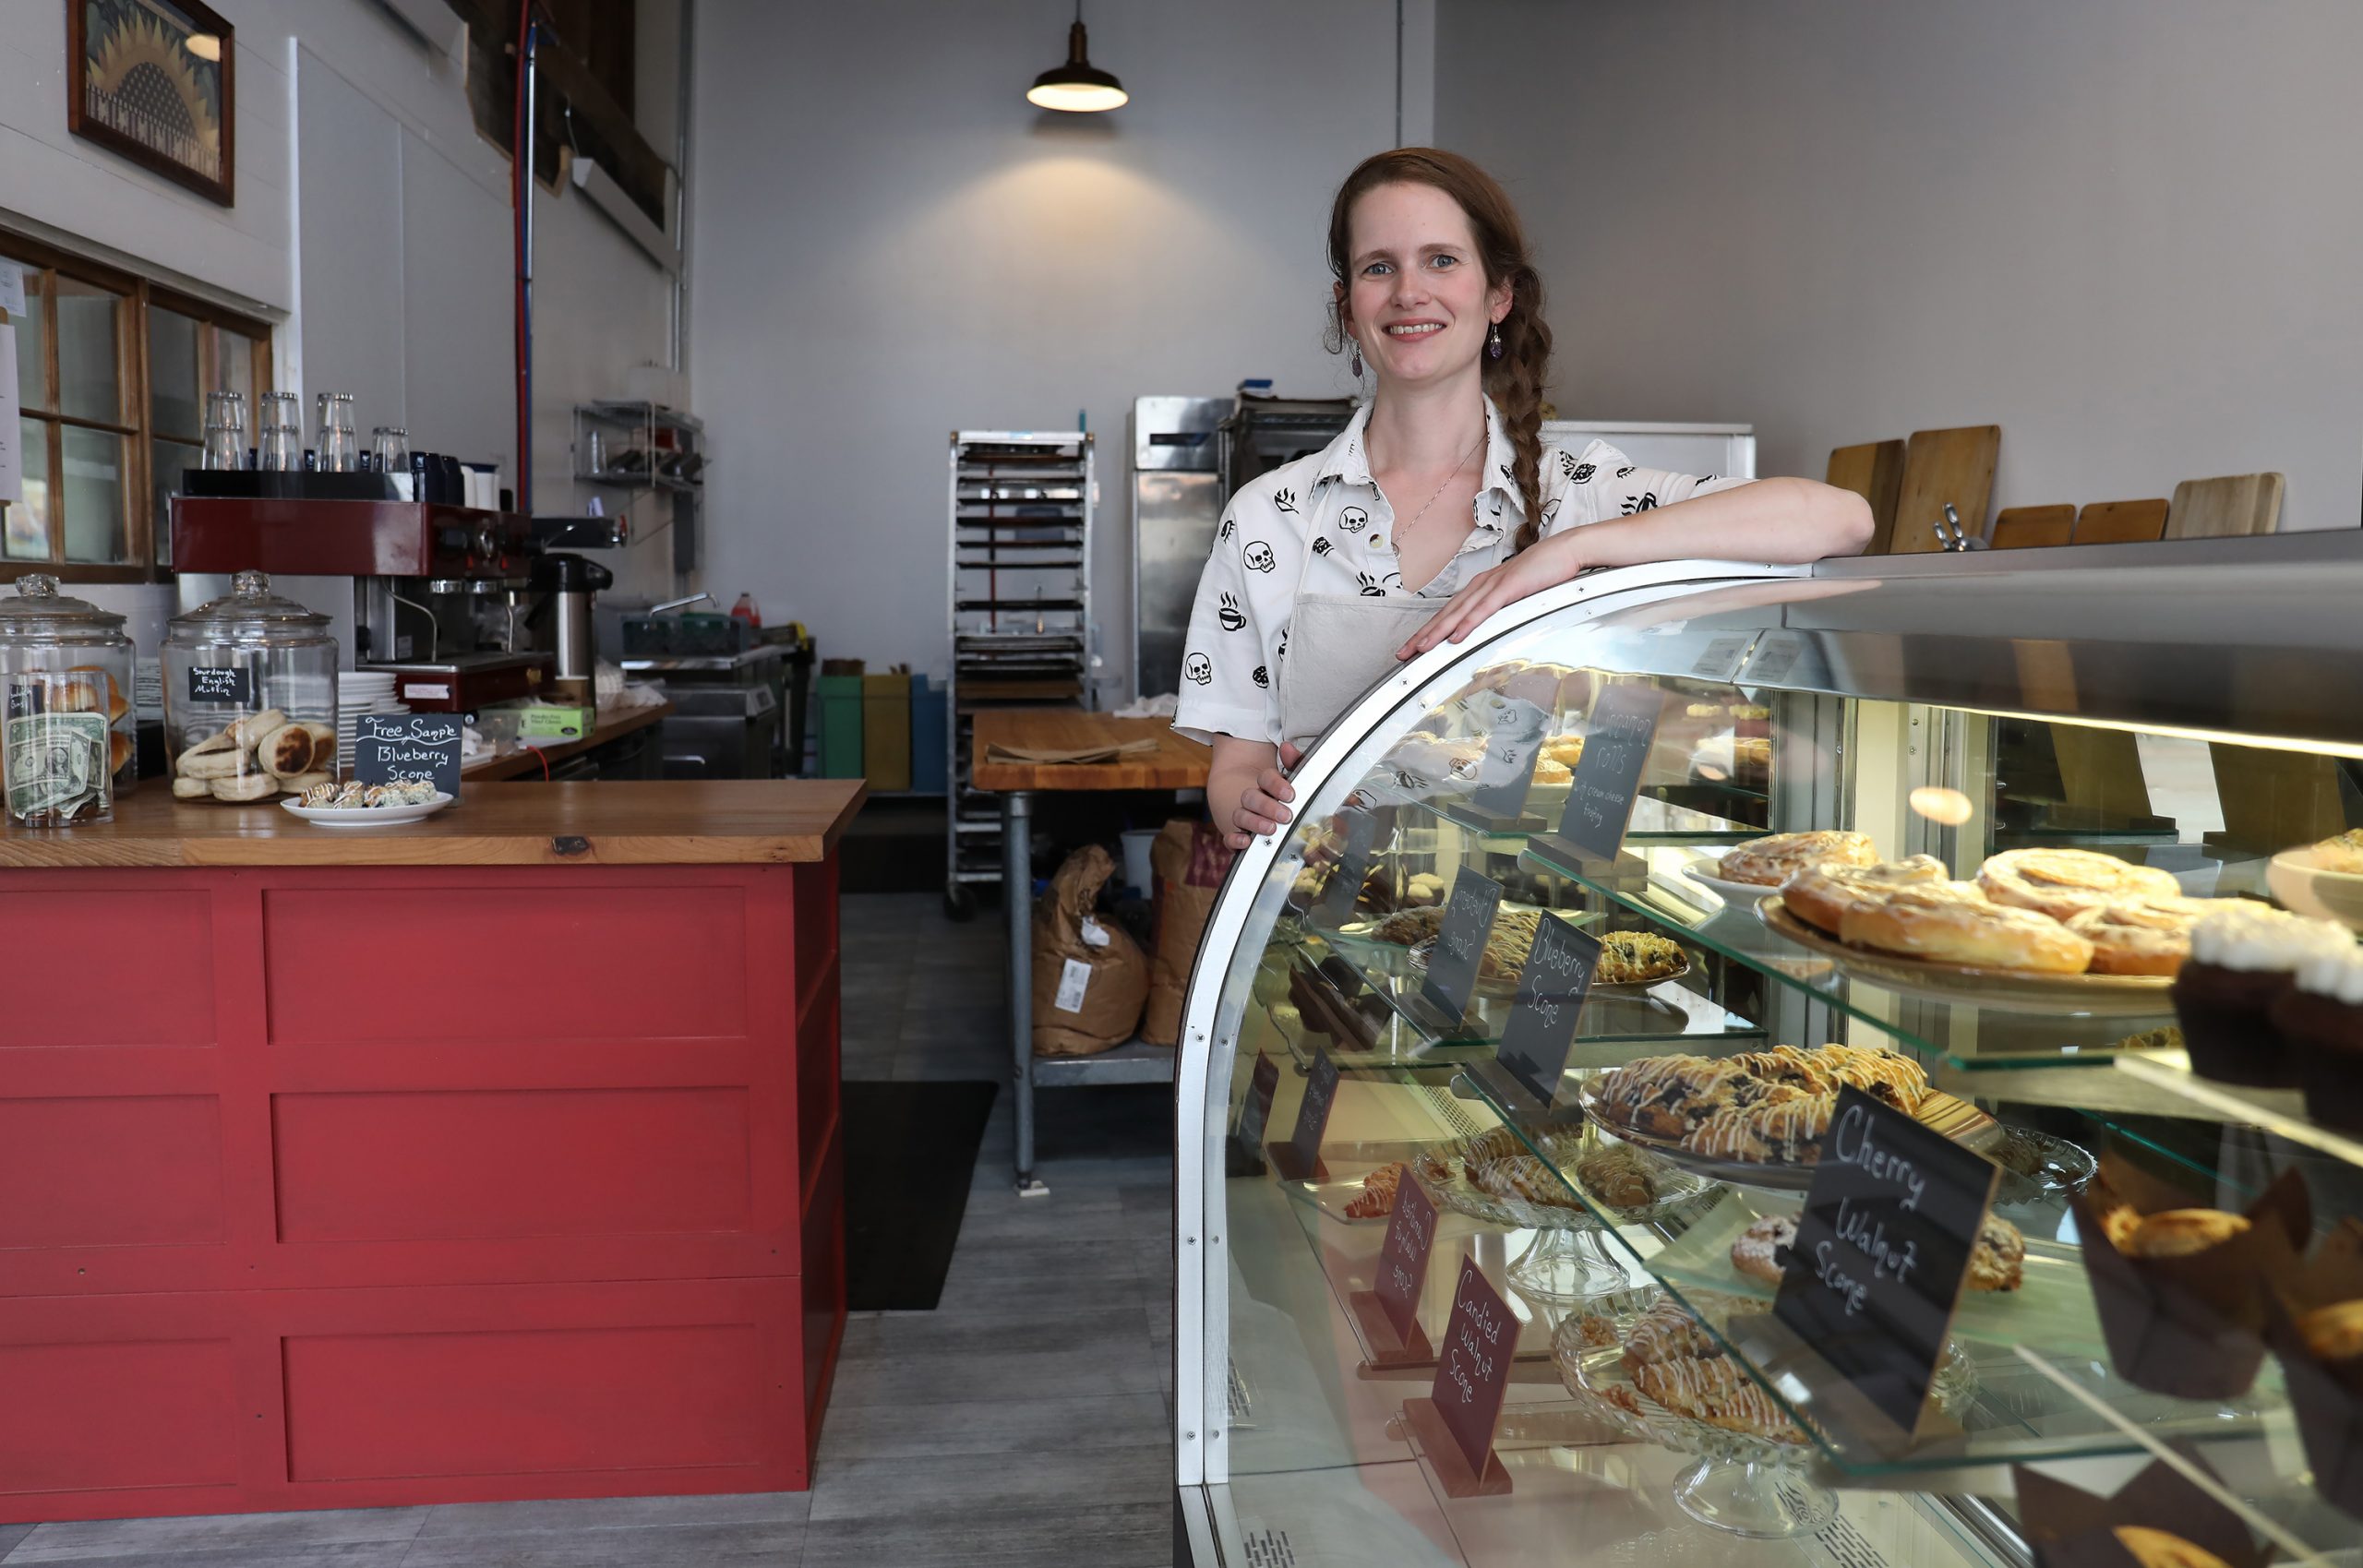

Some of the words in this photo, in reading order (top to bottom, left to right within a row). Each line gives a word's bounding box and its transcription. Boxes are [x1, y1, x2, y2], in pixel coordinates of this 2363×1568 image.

[192, 667, 236, 678] Sourdough
[194, 685, 231, 696] Muffin
[201, 676, 235, 687] English
[366, 716, 403, 736] Free
[411, 719, 457, 740] Sample
[1595, 693, 1652, 747] Cinnamon
[378, 746, 449, 768] Blueberry
[388, 765, 435, 781] Scone
[1595, 745, 1626, 774] rolls
[1534, 917, 1585, 997] Blueberry
[1528, 975, 1559, 1028] Scone
[1836, 1105, 1925, 1212] Cherry
[1836, 1196, 1917, 1283] Walnut
[1815, 1240, 1867, 1316] Scone
[1457, 1269, 1501, 1346] Candied
[1449, 1348, 1473, 1403] Scone
[1460, 1323, 1493, 1382] Walnut
